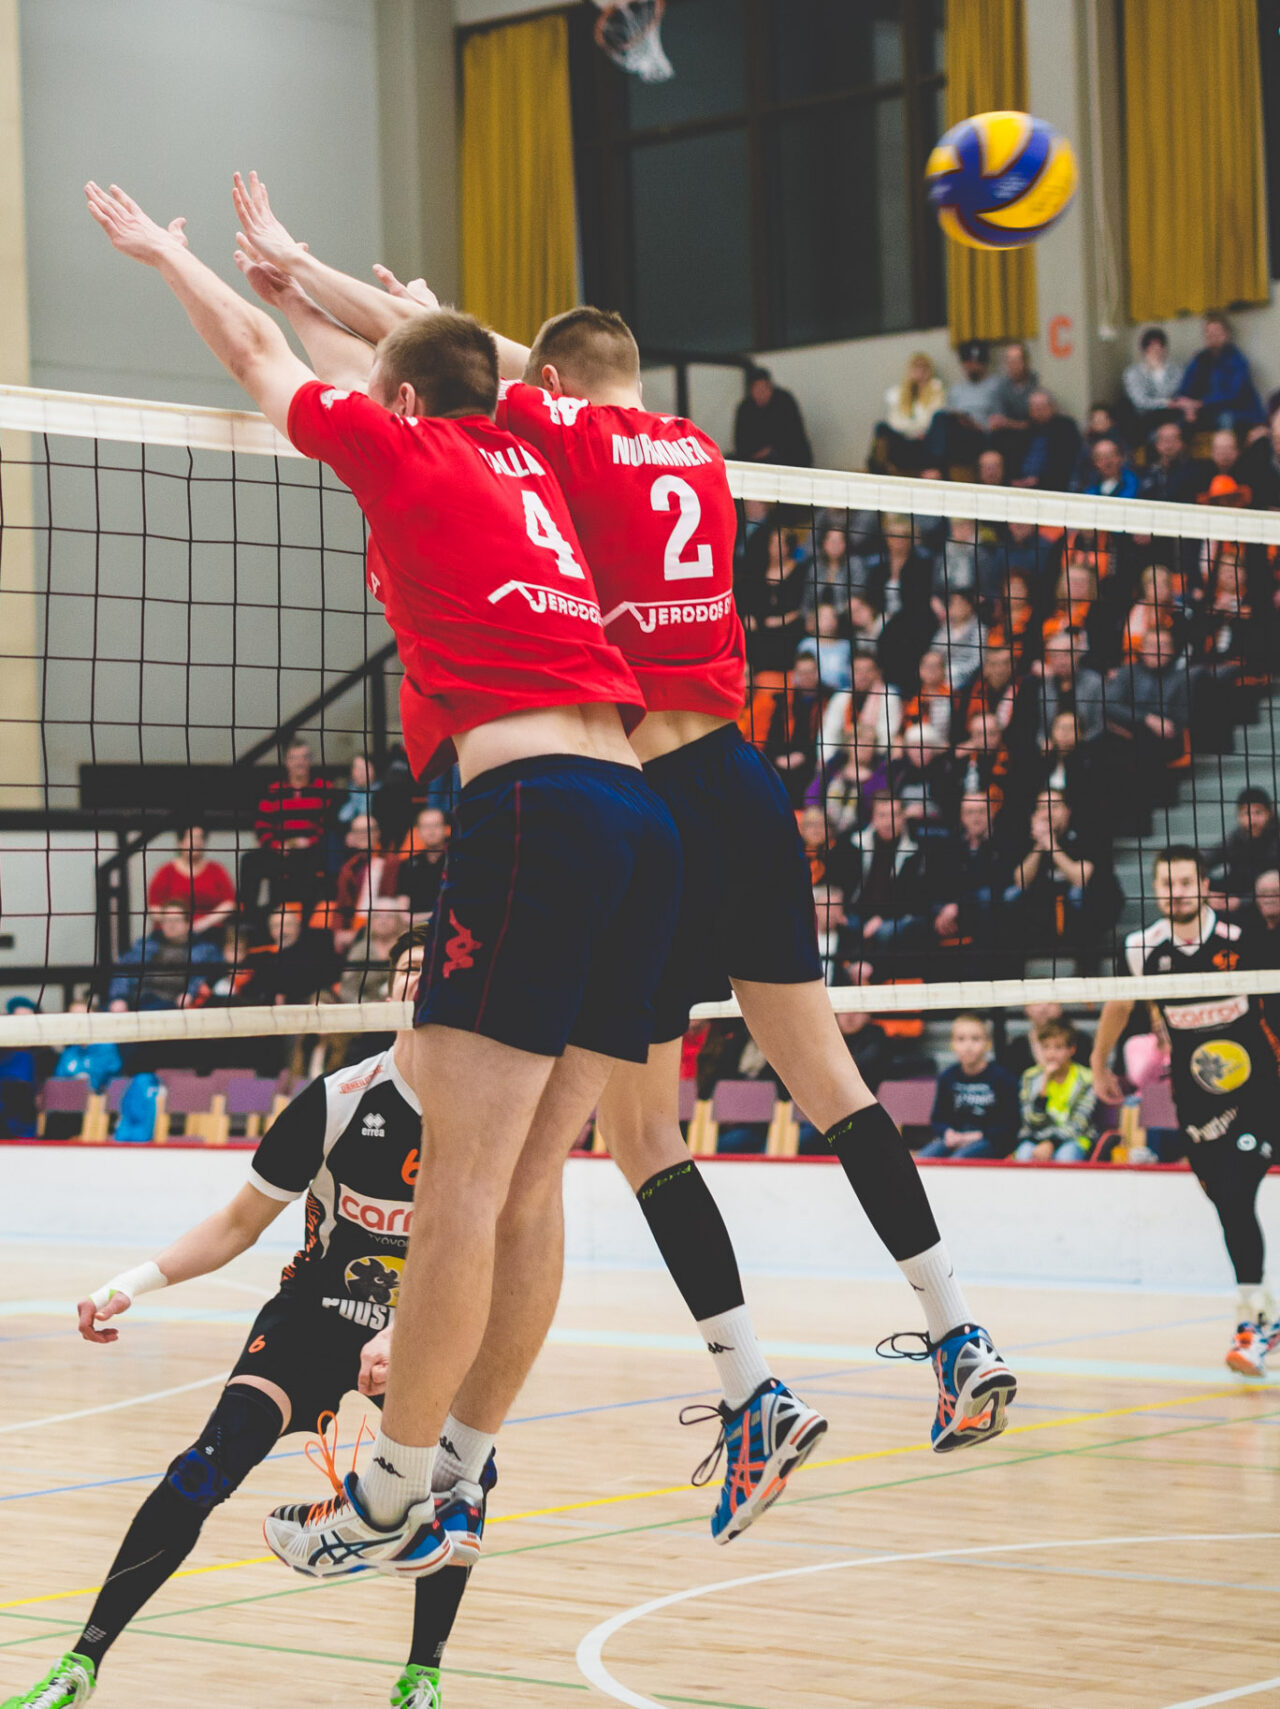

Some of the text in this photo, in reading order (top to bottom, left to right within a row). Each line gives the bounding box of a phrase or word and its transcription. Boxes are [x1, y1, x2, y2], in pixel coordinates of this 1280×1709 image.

[1048, 315, 1073, 358] C
[612, 434, 712, 467] NURMINEN
[521, 489, 585, 579] 4
[650, 474, 714, 581] 2
[639, 602, 723, 633] JERODOS
[401, 1148, 420, 1186] 6
[248, 1334, 266, 1354] 6
